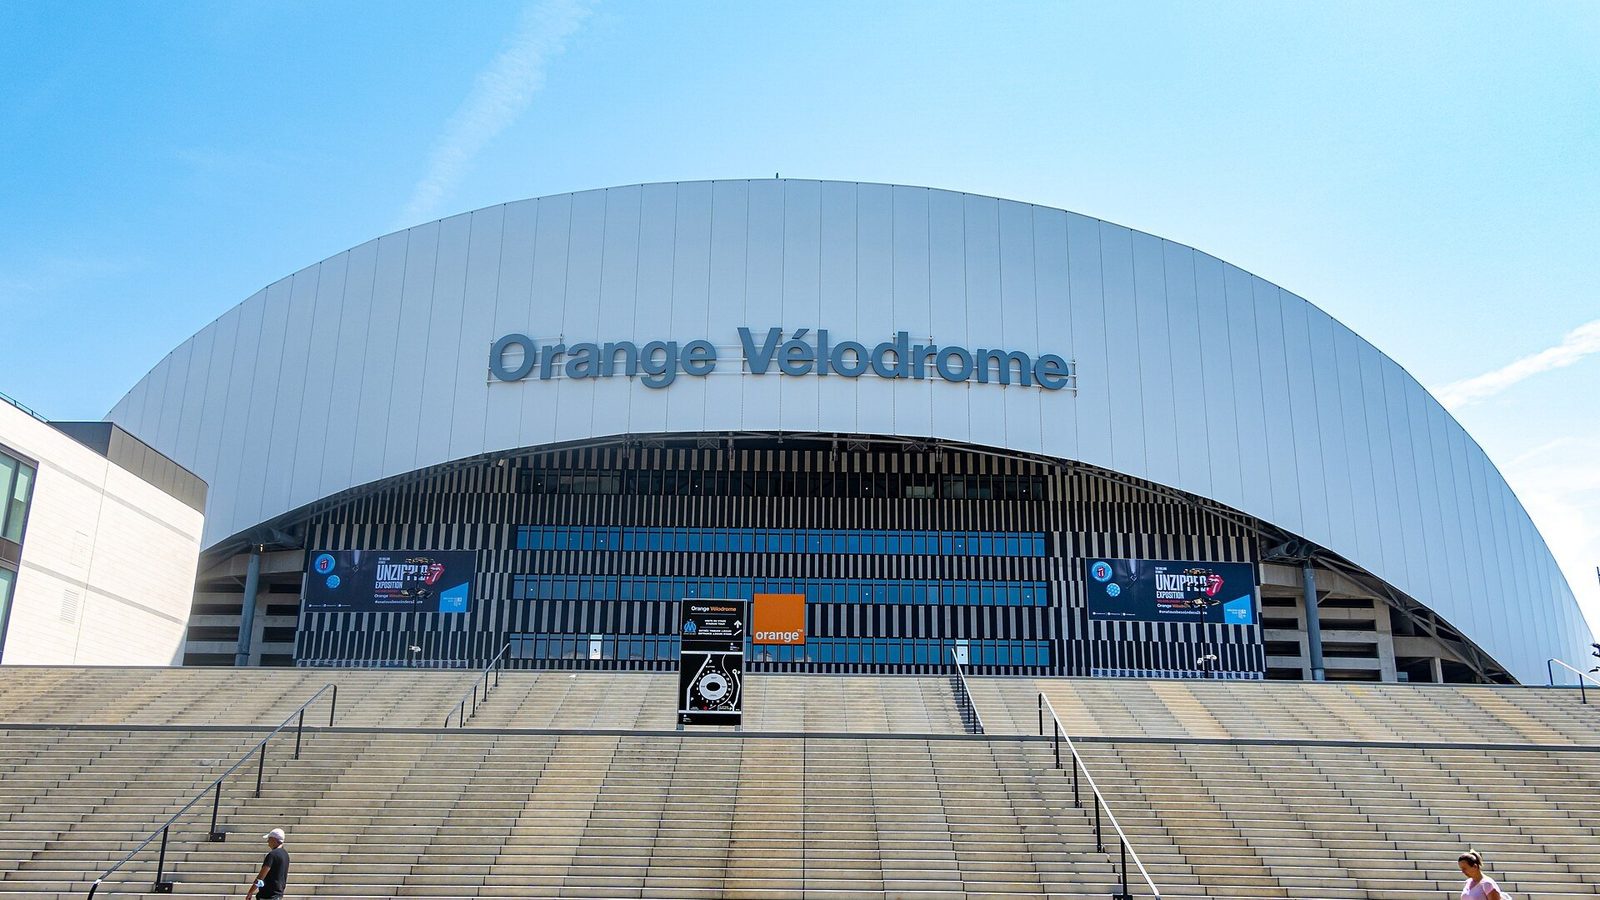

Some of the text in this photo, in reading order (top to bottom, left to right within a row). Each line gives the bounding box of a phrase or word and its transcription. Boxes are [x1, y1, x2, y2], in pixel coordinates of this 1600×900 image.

[489, 327, 1069, 390] Orange Vélodrome
[375, 581, 403, 589] EXPOSITION
[1156, 591, 1184, 599] EXPOSITION
[755, 630, 800, 642] orange
